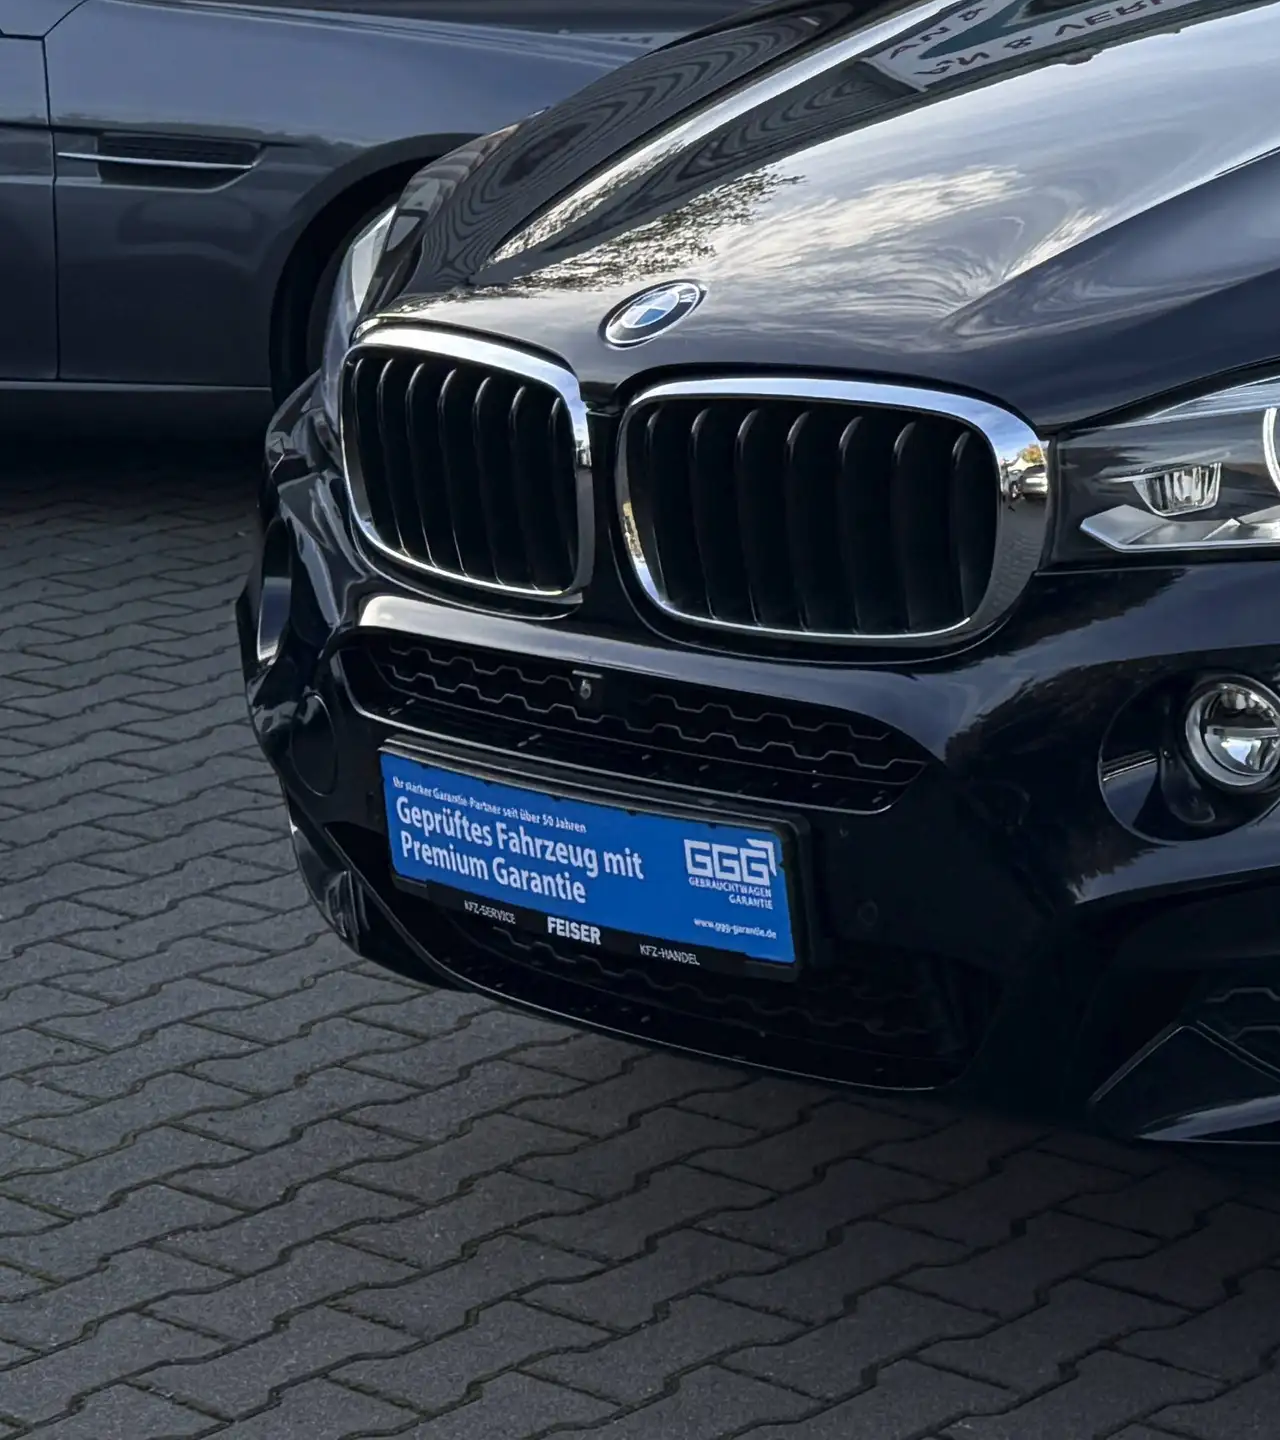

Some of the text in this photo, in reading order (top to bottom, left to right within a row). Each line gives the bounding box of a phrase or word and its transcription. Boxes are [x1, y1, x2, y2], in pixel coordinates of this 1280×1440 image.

[396, 795, 645, 880] Geprüftes Fahrzeug mit
[401, 830, 587, 904] Premium Garantie
[683, 839, 771, 887] GGG
[688, 876, 772, 898] GEBRAUCHTWAGEN
[463, 899, 517, 925] KFZ-SERVICE
[728, 893, 774, 910] GARANTIE
[547, 915, 602, 946] FEISER
[639, 943, 701, 966] KFZ-HANDEL
